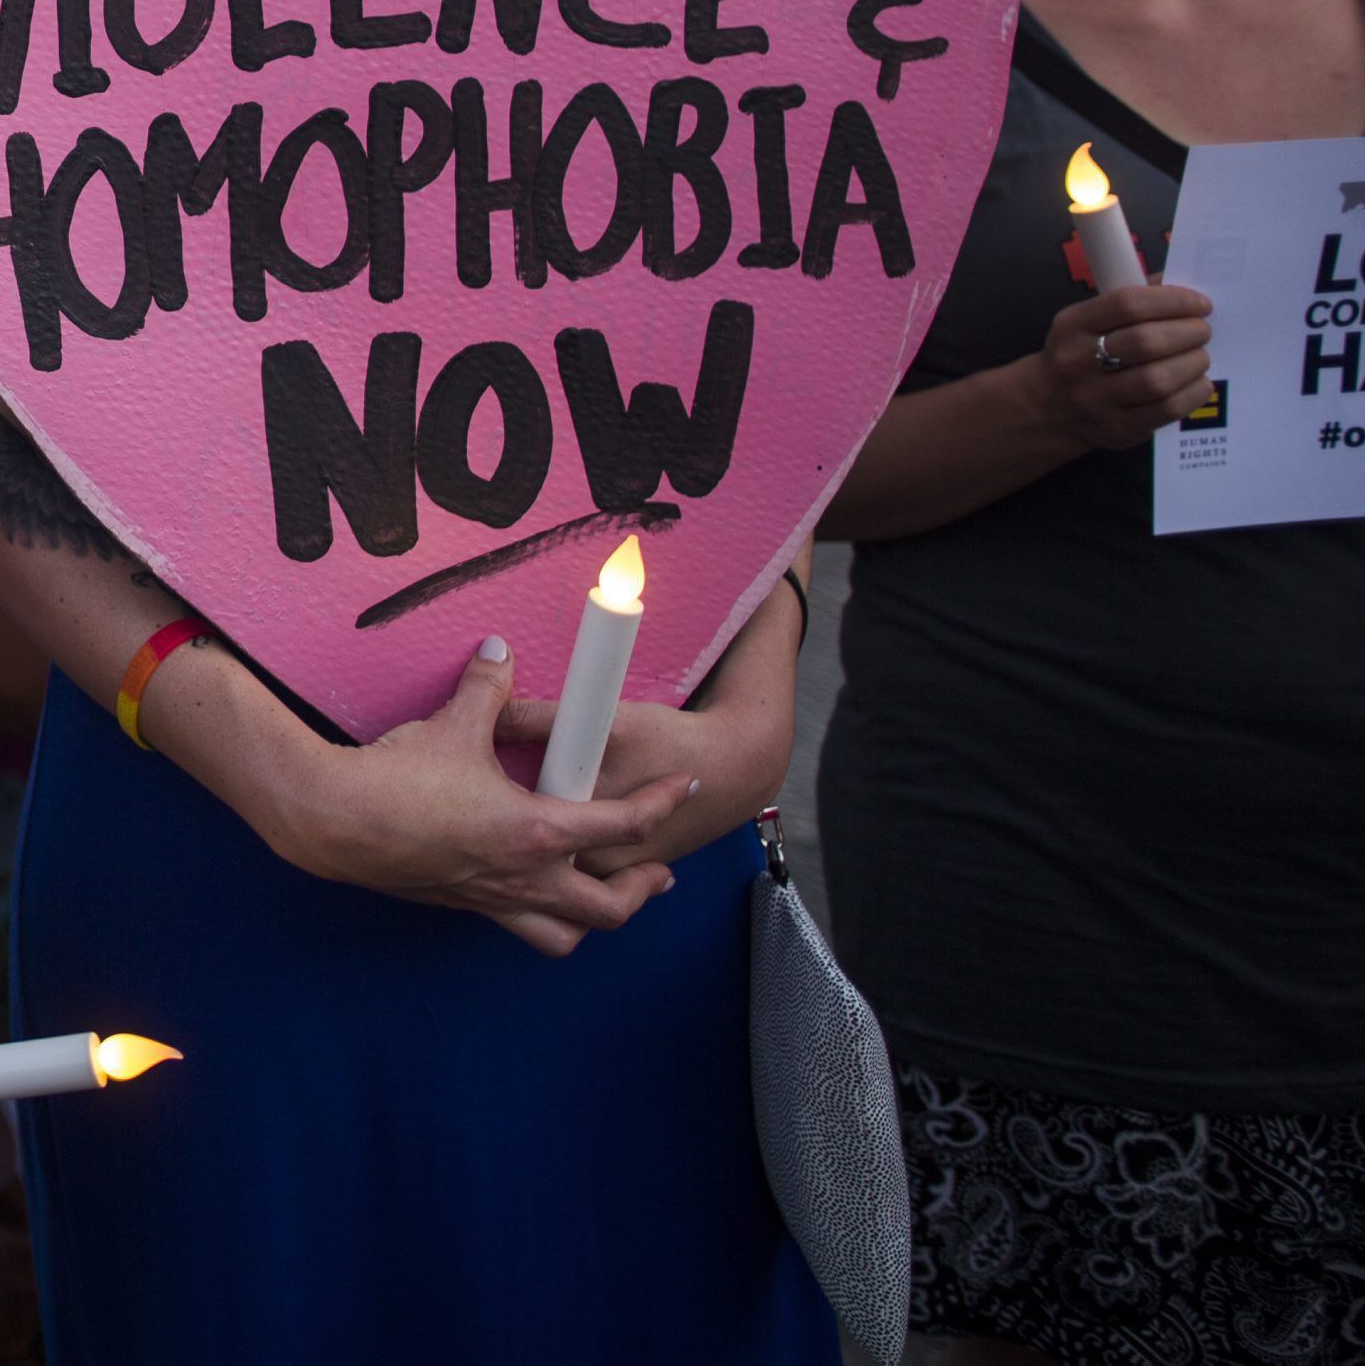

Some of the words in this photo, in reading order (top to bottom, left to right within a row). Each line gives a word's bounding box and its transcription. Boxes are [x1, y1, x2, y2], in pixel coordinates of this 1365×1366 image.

[1314, 233, 1365, 294] L
[1305, 298, 1365, 329] CO
[1301, 331, 1365, 396] H
[261, 300, 754, 562] NOW
[1179, 435, 1228, 448] HUMAN
[1179, 448, 1227, 460] RIGHTS
